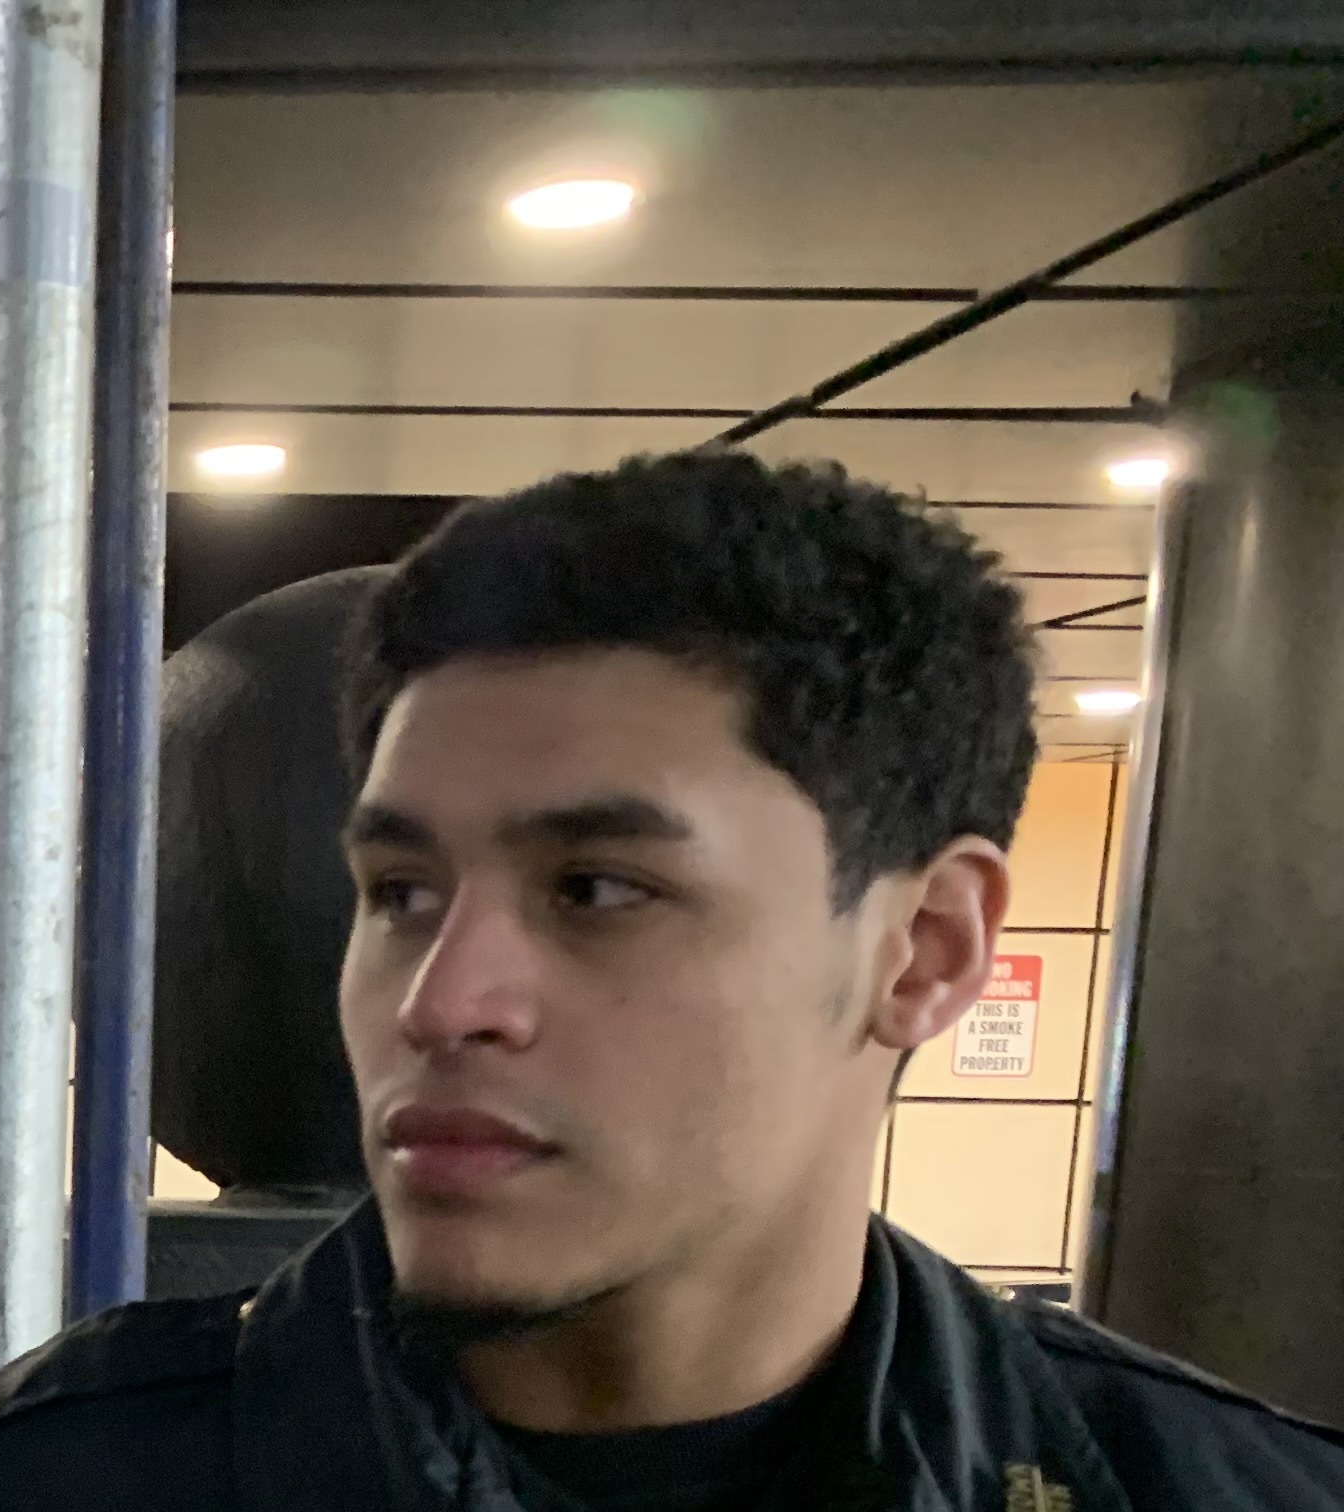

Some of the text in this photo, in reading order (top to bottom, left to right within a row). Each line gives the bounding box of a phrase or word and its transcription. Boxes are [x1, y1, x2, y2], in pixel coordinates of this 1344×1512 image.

[982, 980, 1033, 997] OKING
[976, 1003, 1020, 1017] THIS IS
[968, 1021, 1024, 1035] A SMOKE
[979, 1038, 1010, 1053] FREE
[960, 1056, 1025, 1071] PROPERTY
